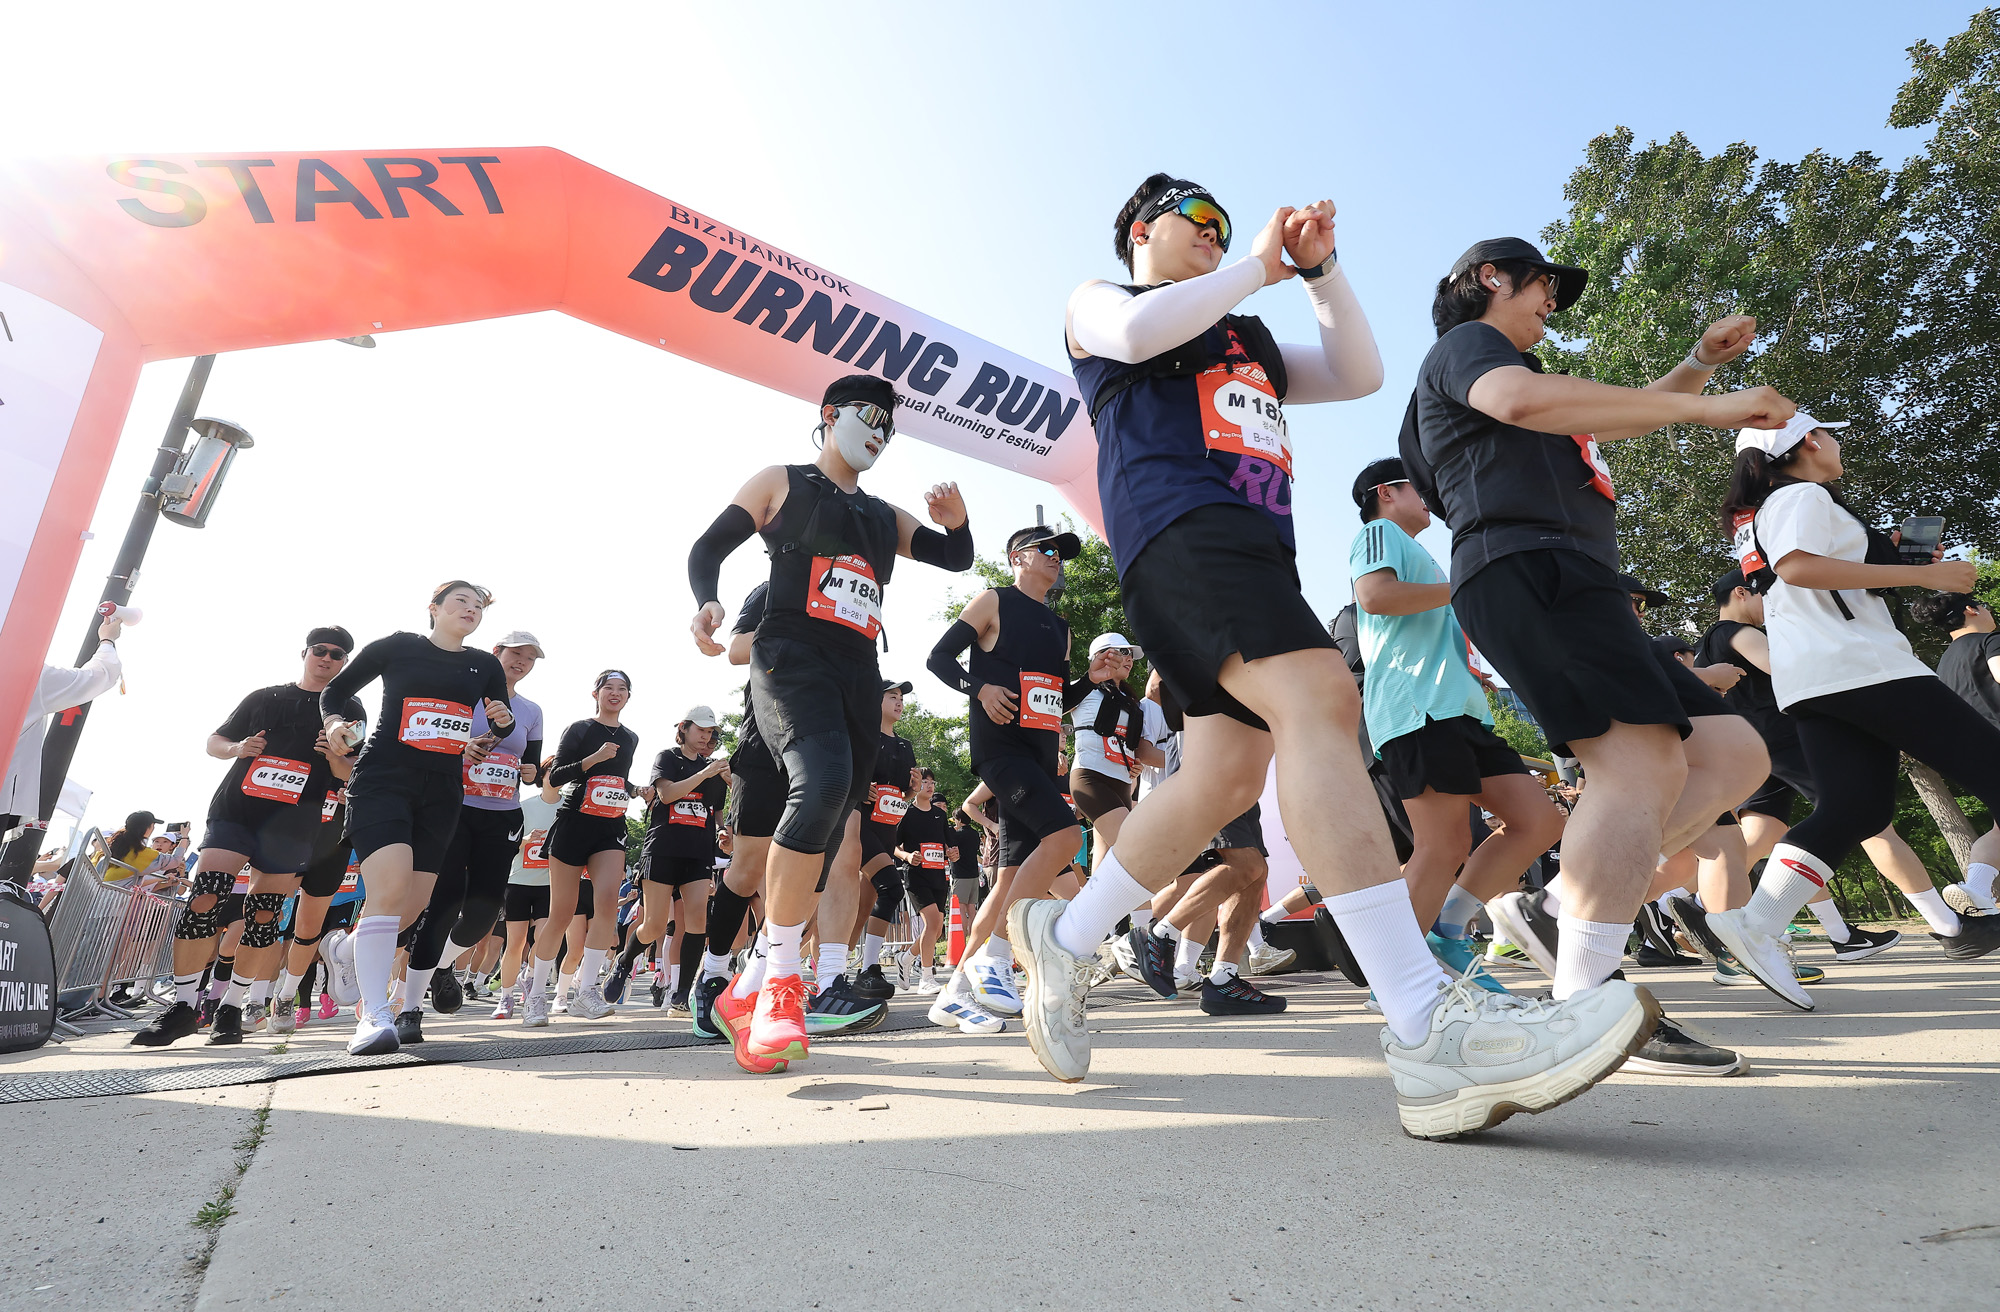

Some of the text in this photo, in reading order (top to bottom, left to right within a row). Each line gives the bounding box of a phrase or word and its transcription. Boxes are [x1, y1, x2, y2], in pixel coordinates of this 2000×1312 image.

[105, 155, 505, 228] START
[627, 226, 1081, 442] BURNING RUN
[1228, 393, 1245, 408] M
[898, 393, 1052, 457] sual Running Festival
[1253, 432, 1275, 447] B-51
[1229, 454, 1291, 515] RU
[829, 577, 843, 588] M
[1033, 694, 1041, 703] M
[416, 717, 470, 733] W 4585
[271, 772, 305, 786] 1492
[486, 767, 515, 780] 3581
[0, 941, 18, 972] ART
[0, 981, 49, 1012] TING LINE
